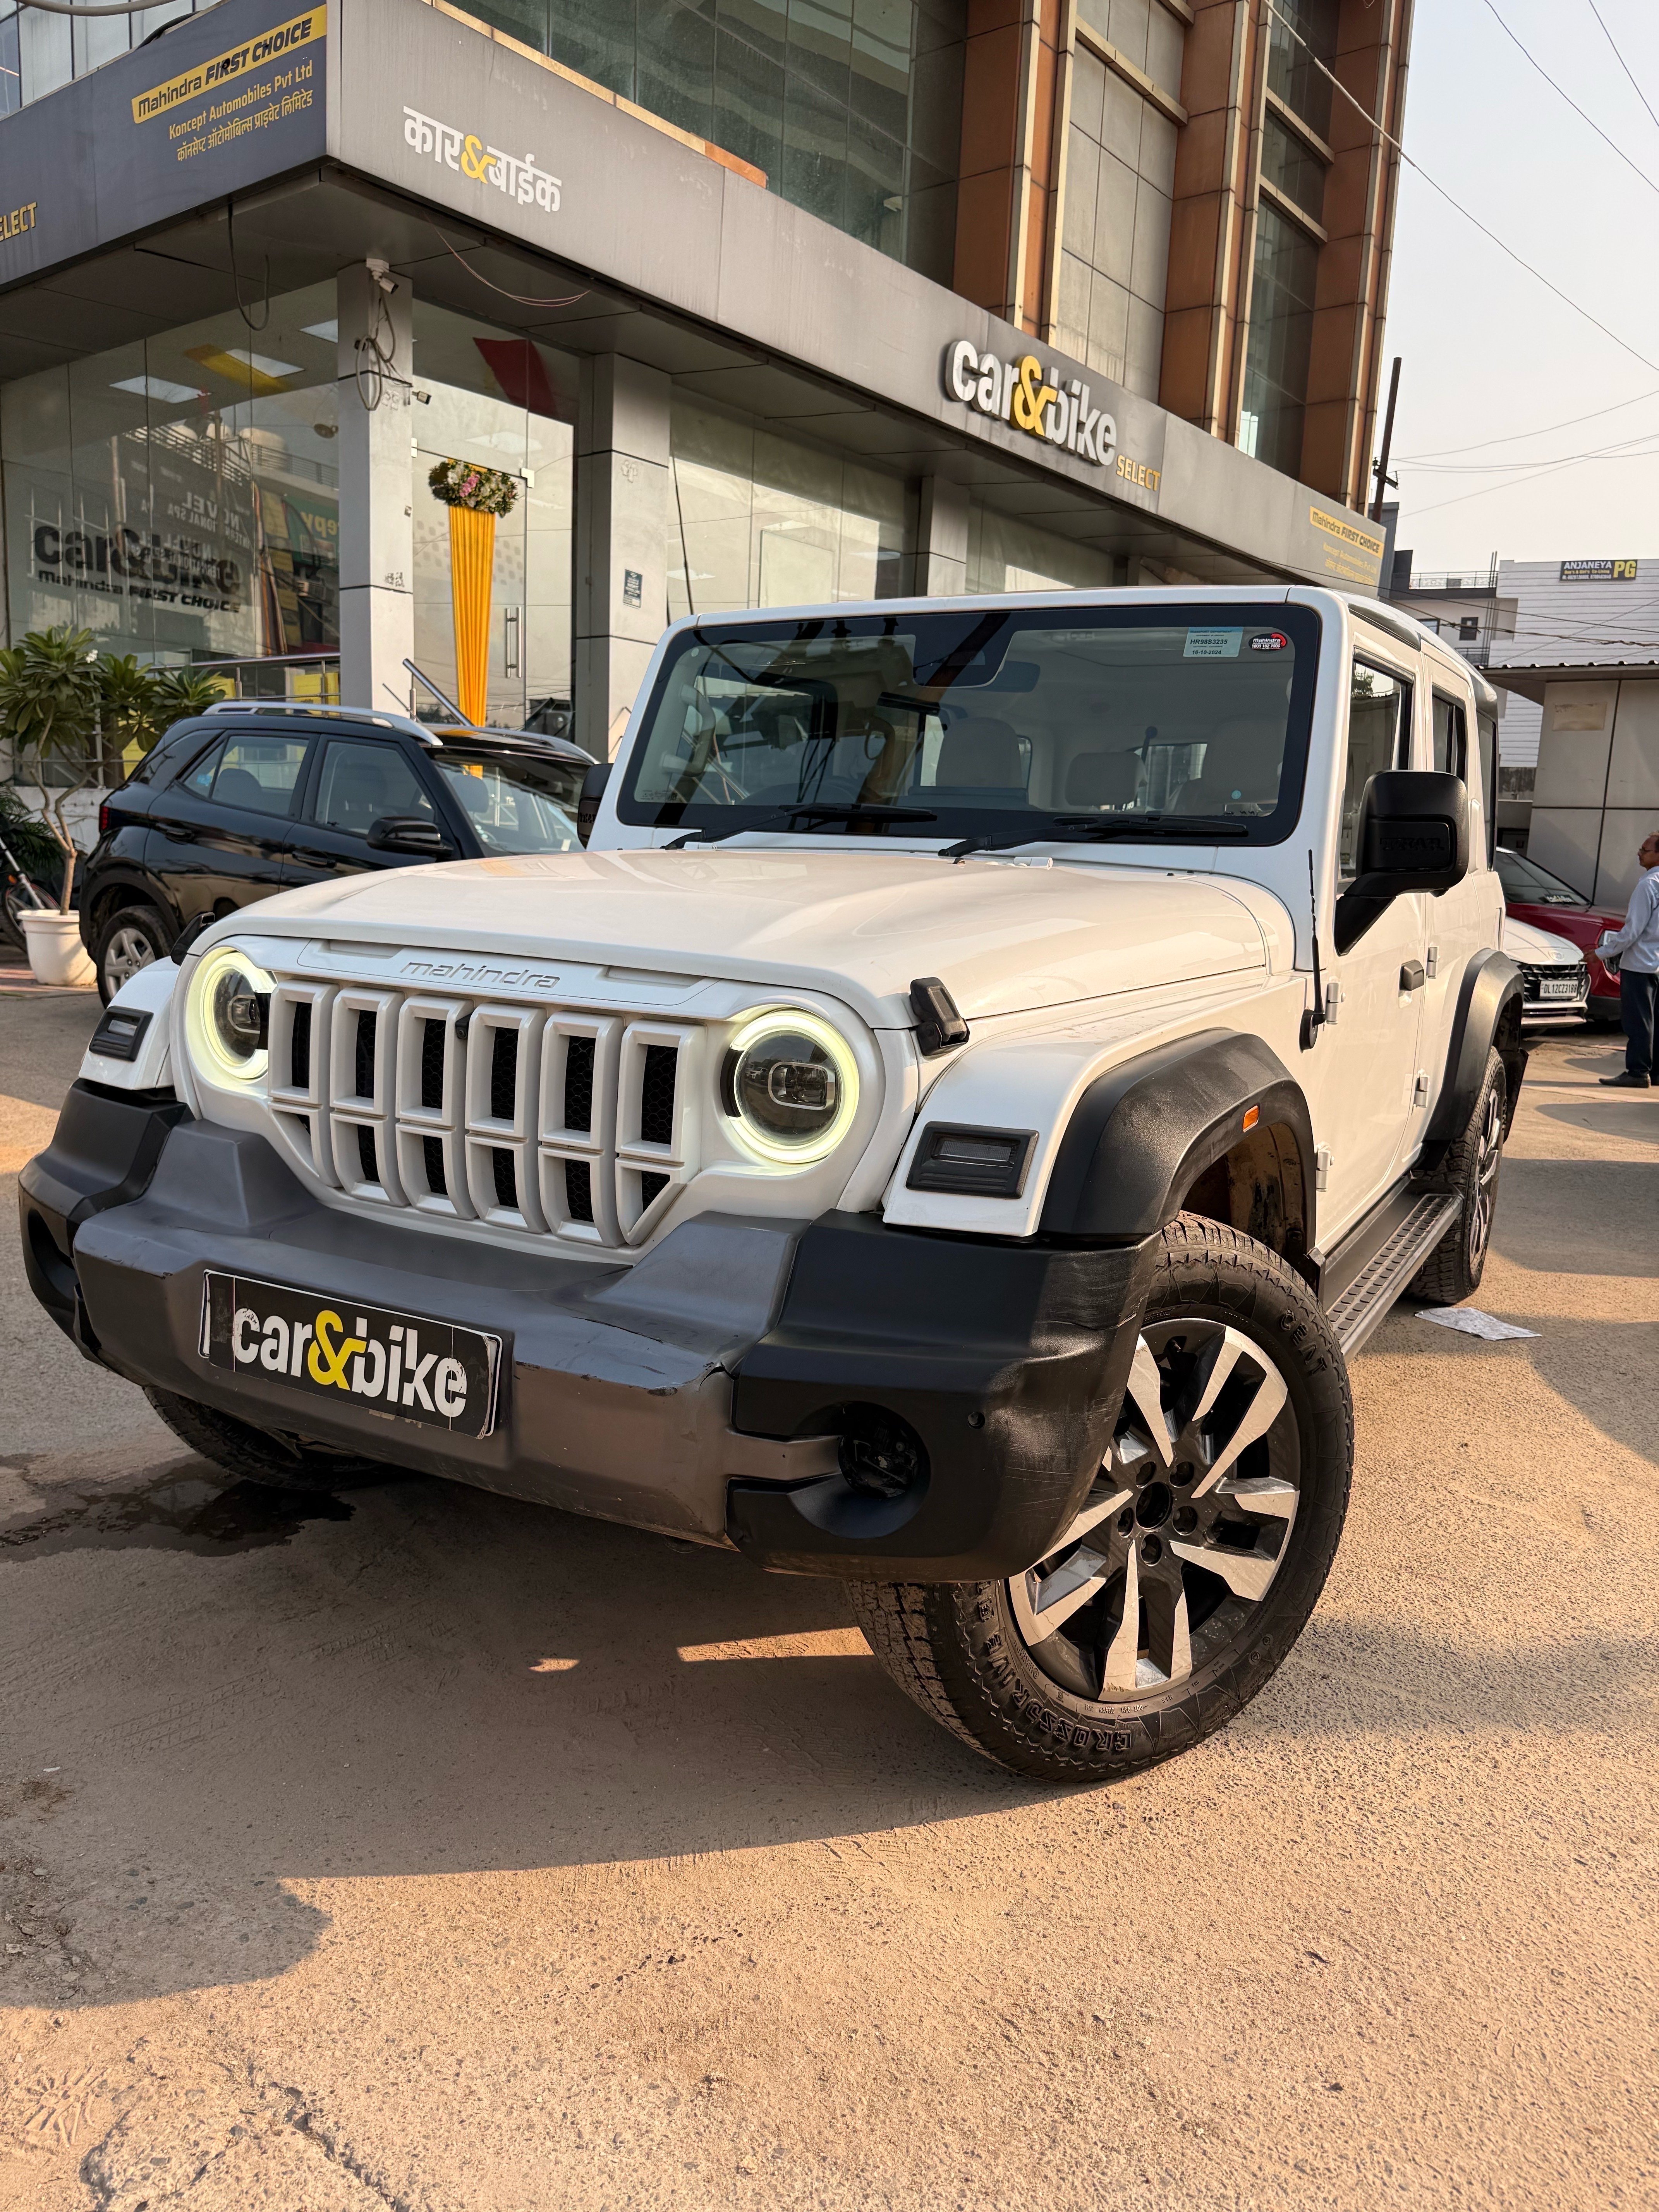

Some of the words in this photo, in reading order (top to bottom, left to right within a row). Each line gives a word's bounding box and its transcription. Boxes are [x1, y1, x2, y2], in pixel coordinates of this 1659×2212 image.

[139, 76, 201, 117] Mahindra
[205, 47, 250, 85] FIRST
[252, 17, 312, 62] CHOICE
[169, 110, 206, 140] Koncept
[209, 82, 271, 122] Automobiles
[274, 71, 293, 92] Pvt
[295, 60, 313, 82] Ltd
[947, 340, 1116, 466] car&bike
[1116, 455, 1161, 491] SELECT
[1312, 511, 1341, 534] Mahindra
[1341, 527, 1359, 543] FIRST
[1359, 535, 1380, 553] CHOICE
[1564, 561, 1612, 569] ANJANEYA
[1613, 561, 1637, 578] PG
[181, 594, 241, 613] CHOICE
[400, 962, 560, 989] mahindra
[233, 1307, 467, 1418] car&bike
